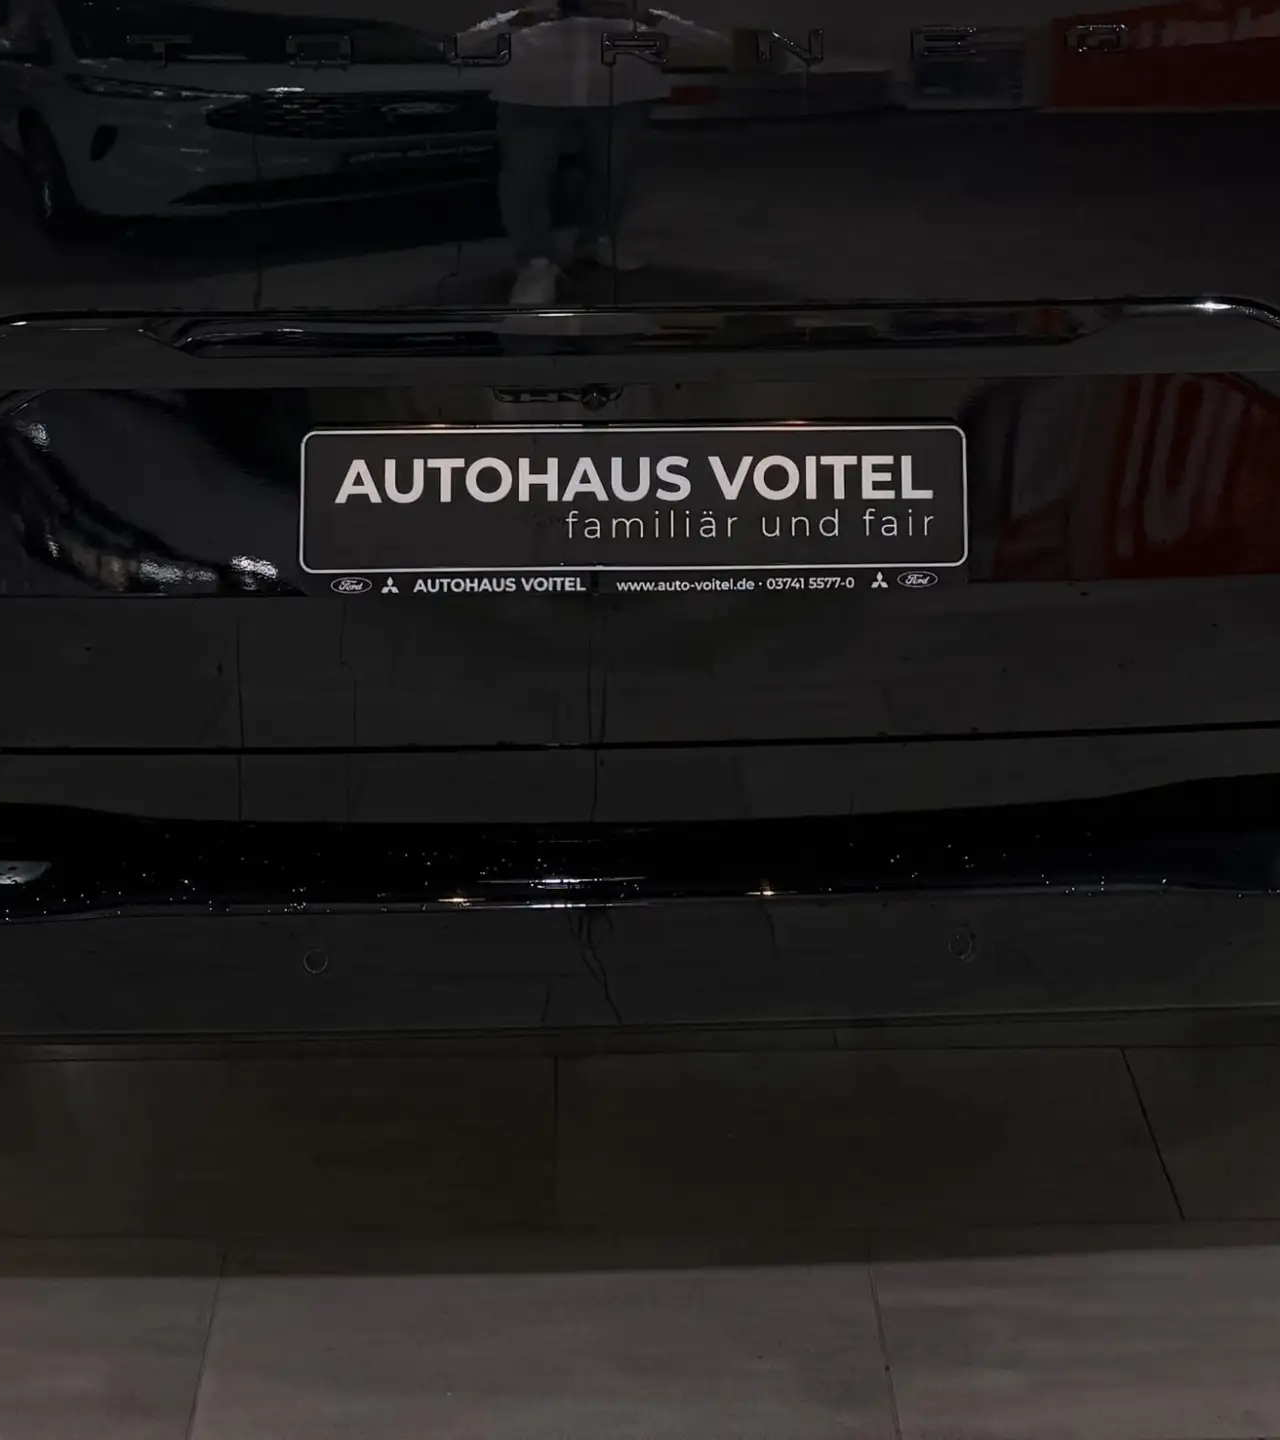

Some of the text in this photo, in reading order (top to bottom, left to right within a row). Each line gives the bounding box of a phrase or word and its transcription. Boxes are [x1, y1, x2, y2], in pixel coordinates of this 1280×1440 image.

[334, 455, 934, 504] AUTOHAUS VOITEL
[565, 508, 935, 539] familiär und fair
[340, 580, 364, 590] Ford
[413, 578, 586, 592] AUTOHAUS VOITEL
[616, 577, 855, 591] www.auto-voitel.de 03741 5577-0
[905, 574, 928, 585] Ford
